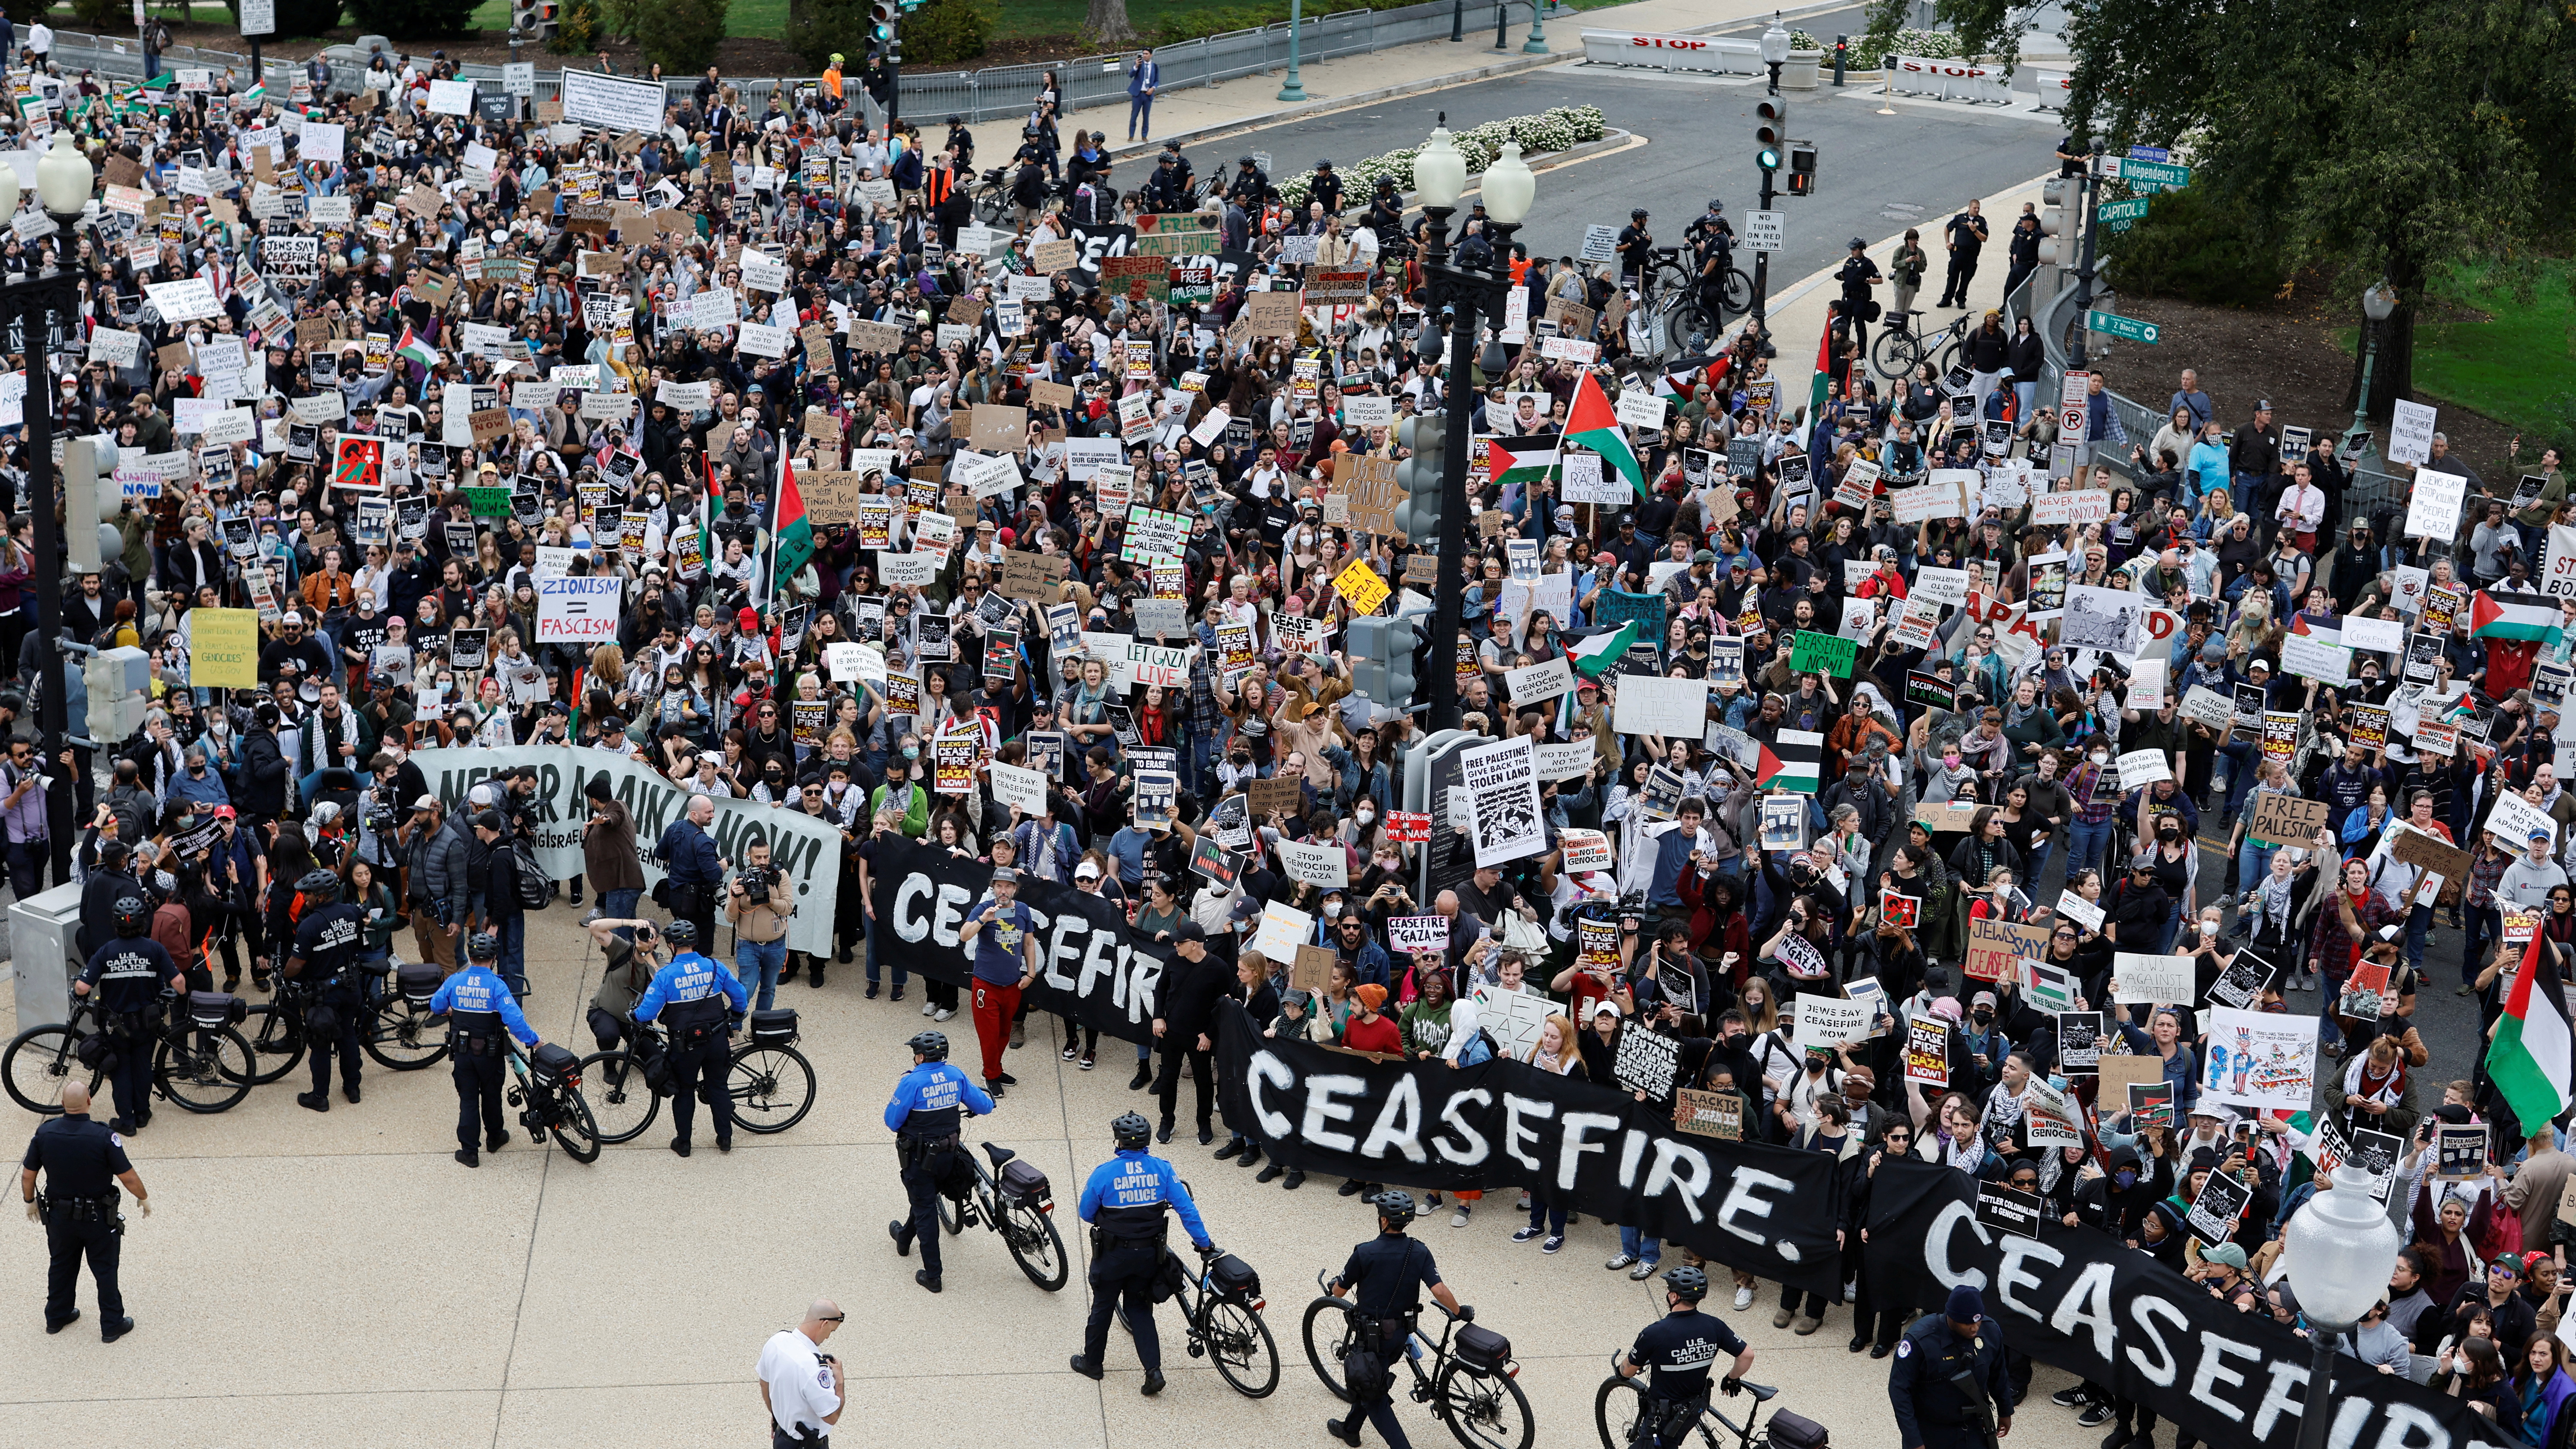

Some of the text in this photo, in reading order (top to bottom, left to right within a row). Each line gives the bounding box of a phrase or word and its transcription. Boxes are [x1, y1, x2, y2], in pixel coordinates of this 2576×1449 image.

[1633, 37, 1707, 50] STOP
[1904, 62, 1985, 78] STOP
[2132, 148, 2166, 159] EVACUATION ROUTE
[2125, 161, 2174, 182] Independence
[2133, 181, 2157, 192] UNIT
[2099, 203, 2137, 221] CAPITOL
[2112, 219, 2130, 230] 100
[267, 240, 314, 251] JEWS SAY
[266, 252, 315, 262] CEASEFIRE
[1181, 270, 1207, 284] FREE
[1172, 286, 1211, 300] PALESTINE
[1306, 281, 1364, 291] STOP US-FUNDED
[1324, 296, 1365, 304] PALESTINE
[2120, 323, 2137, 333] Blocks
[199, 345, 239, 357] GENOCIDE
[201, 365, 223, 374] Jewish
[2399, 405, 2433, 421] COLLECTIVE
[2403, 416, 2431, 430] PUNISHMENT
[2396, 427, 2429, 443] PALESTINIANS
[2393, 444, 2426, 463] WAR CRIME
[2423, 475, 2461, 490] JEWS SAY:
[2040, 495, 2105, 506] NEVER AGAIN
[2419, 487, 2458, 505] STOP KILLING
[2036, 511, 2052, 519] NOT
[2069, 505, 2108, 520] ANYONE
[2423, 505, 2451, 518] PEOPLE
[1142, 520, 1175, 532] JEWISH
[2423, 519, 2450, 534] GAZA
[1136, 529, 1179, 542] SOLIDARITY
[1134, 541, 1175, 554] PALESTINE
[543, 578, 619, 595] ZIONISM
[542, 618, 616, 636] FASCISM
[2287, 645, 2309, 654] liberation
[2288, 638, 2316, 648] Anti-Zionist
[1127, 644, 1186, 668] LET GAZA
[2287, 651, 2311, 662] Palestinian
[1137, 664, 1179, 685] LIVE
[2295, 668, 2318, 677] ancestors
[1909, 687, 1952, 706] IS A CRIME
[1910, 680, 1952, 699] OCCUPATION
[938, 747, 971, 756] CEASE
[1466, 745, 1530, 770] FREE PALESTINE!
[941, 757, 968, 765] FIRE
[1468, 757, 1529, 778] GIVE BACK THE
[937, 770, 971, 778] GAZA
[2120, 761, 2166, 776] Israeli Apartheid
[1470, 766, 1531, 790] STOLEN LAND
[1400, 813, 1431, 822] GENOCIDE
[1388, 829, 1431, 838] MY NAME
[1498, 843, 1514, 851] ISRAELI
[1515, 836, 1543, 847] OCCUPATION
[1389, 917, 1445, 928] CEASEFIRE
[1400, 929, 1431, 944] GAZA
[106, 958, 151, 967] CAPITOL
[1248, 1050, 1801, 1263] CEASEFIRE.
[1125, 1161, 1145, 1174] U.S.
[1113, 1174, 1160, 1190] CAPITOL
[1119, 1188, 1157, 1203] POLICE
[1979, 1193, 2038, 1218] SETTLER COLONIALISM
[1991, 1205, 2025, 1223] IS GENOCIDE
